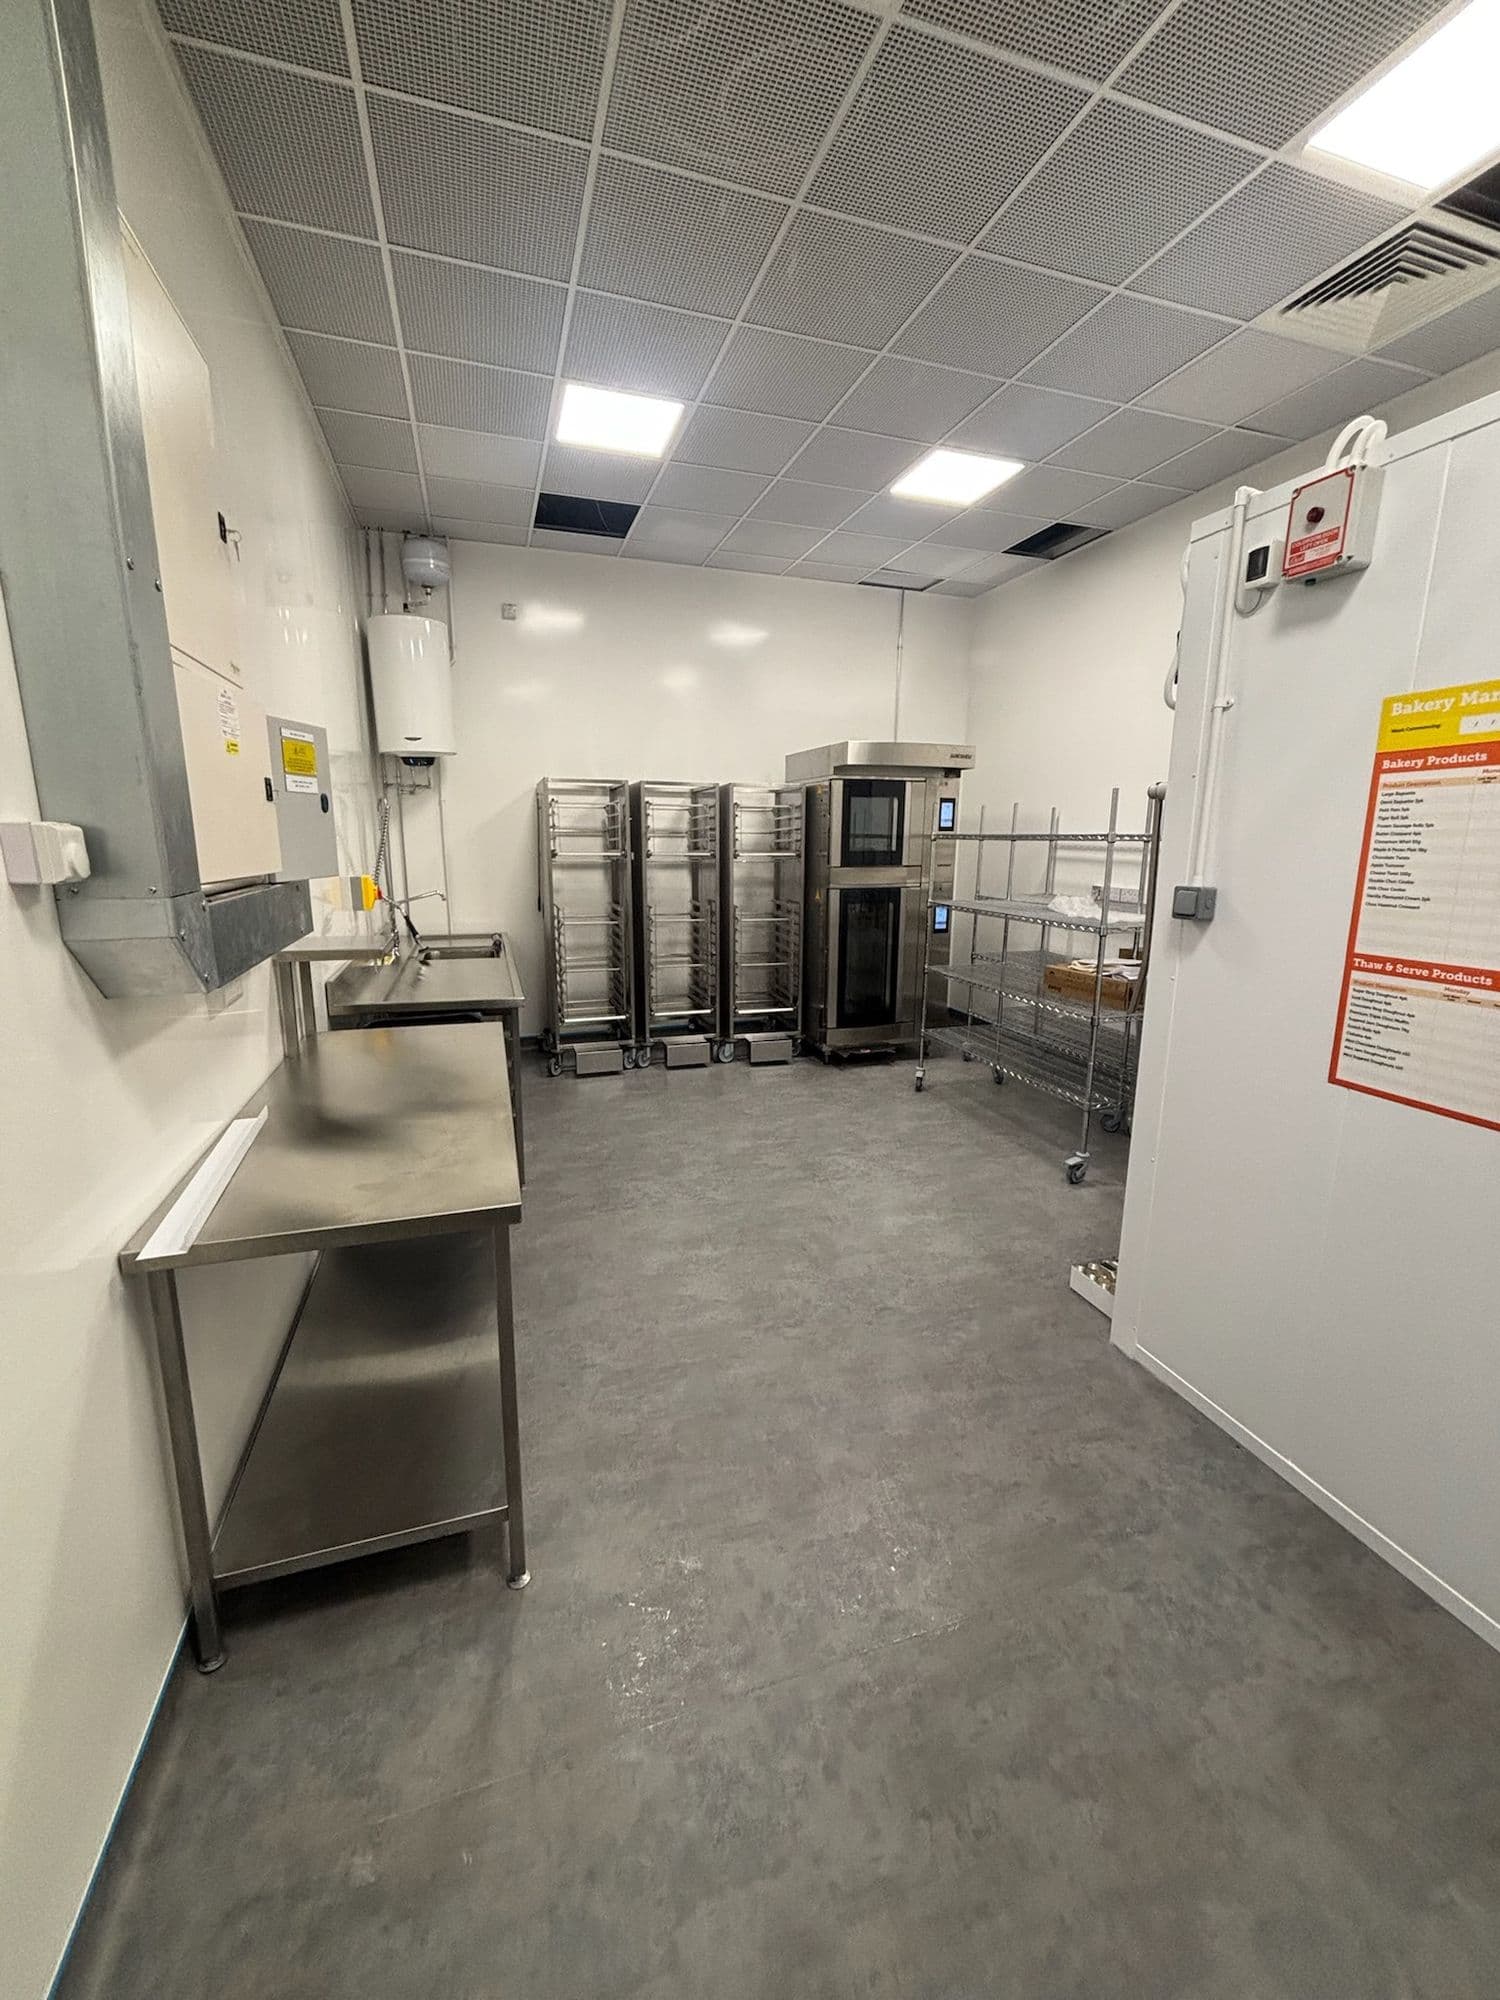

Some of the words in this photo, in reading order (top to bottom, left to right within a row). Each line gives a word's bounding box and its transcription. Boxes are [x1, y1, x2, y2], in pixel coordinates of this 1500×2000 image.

[1391, 697, 1456, 717] Bakery
[1382, 758, 1424, 770] Bakery
[1426, 752, 1488, 766] Products
[1353, 957, 1383, 971] Thaw
[1385, 961, 1394, 972] &
[1395, 964, 1429, 977] Serve
[1431, 969, 1493, 986] Products
